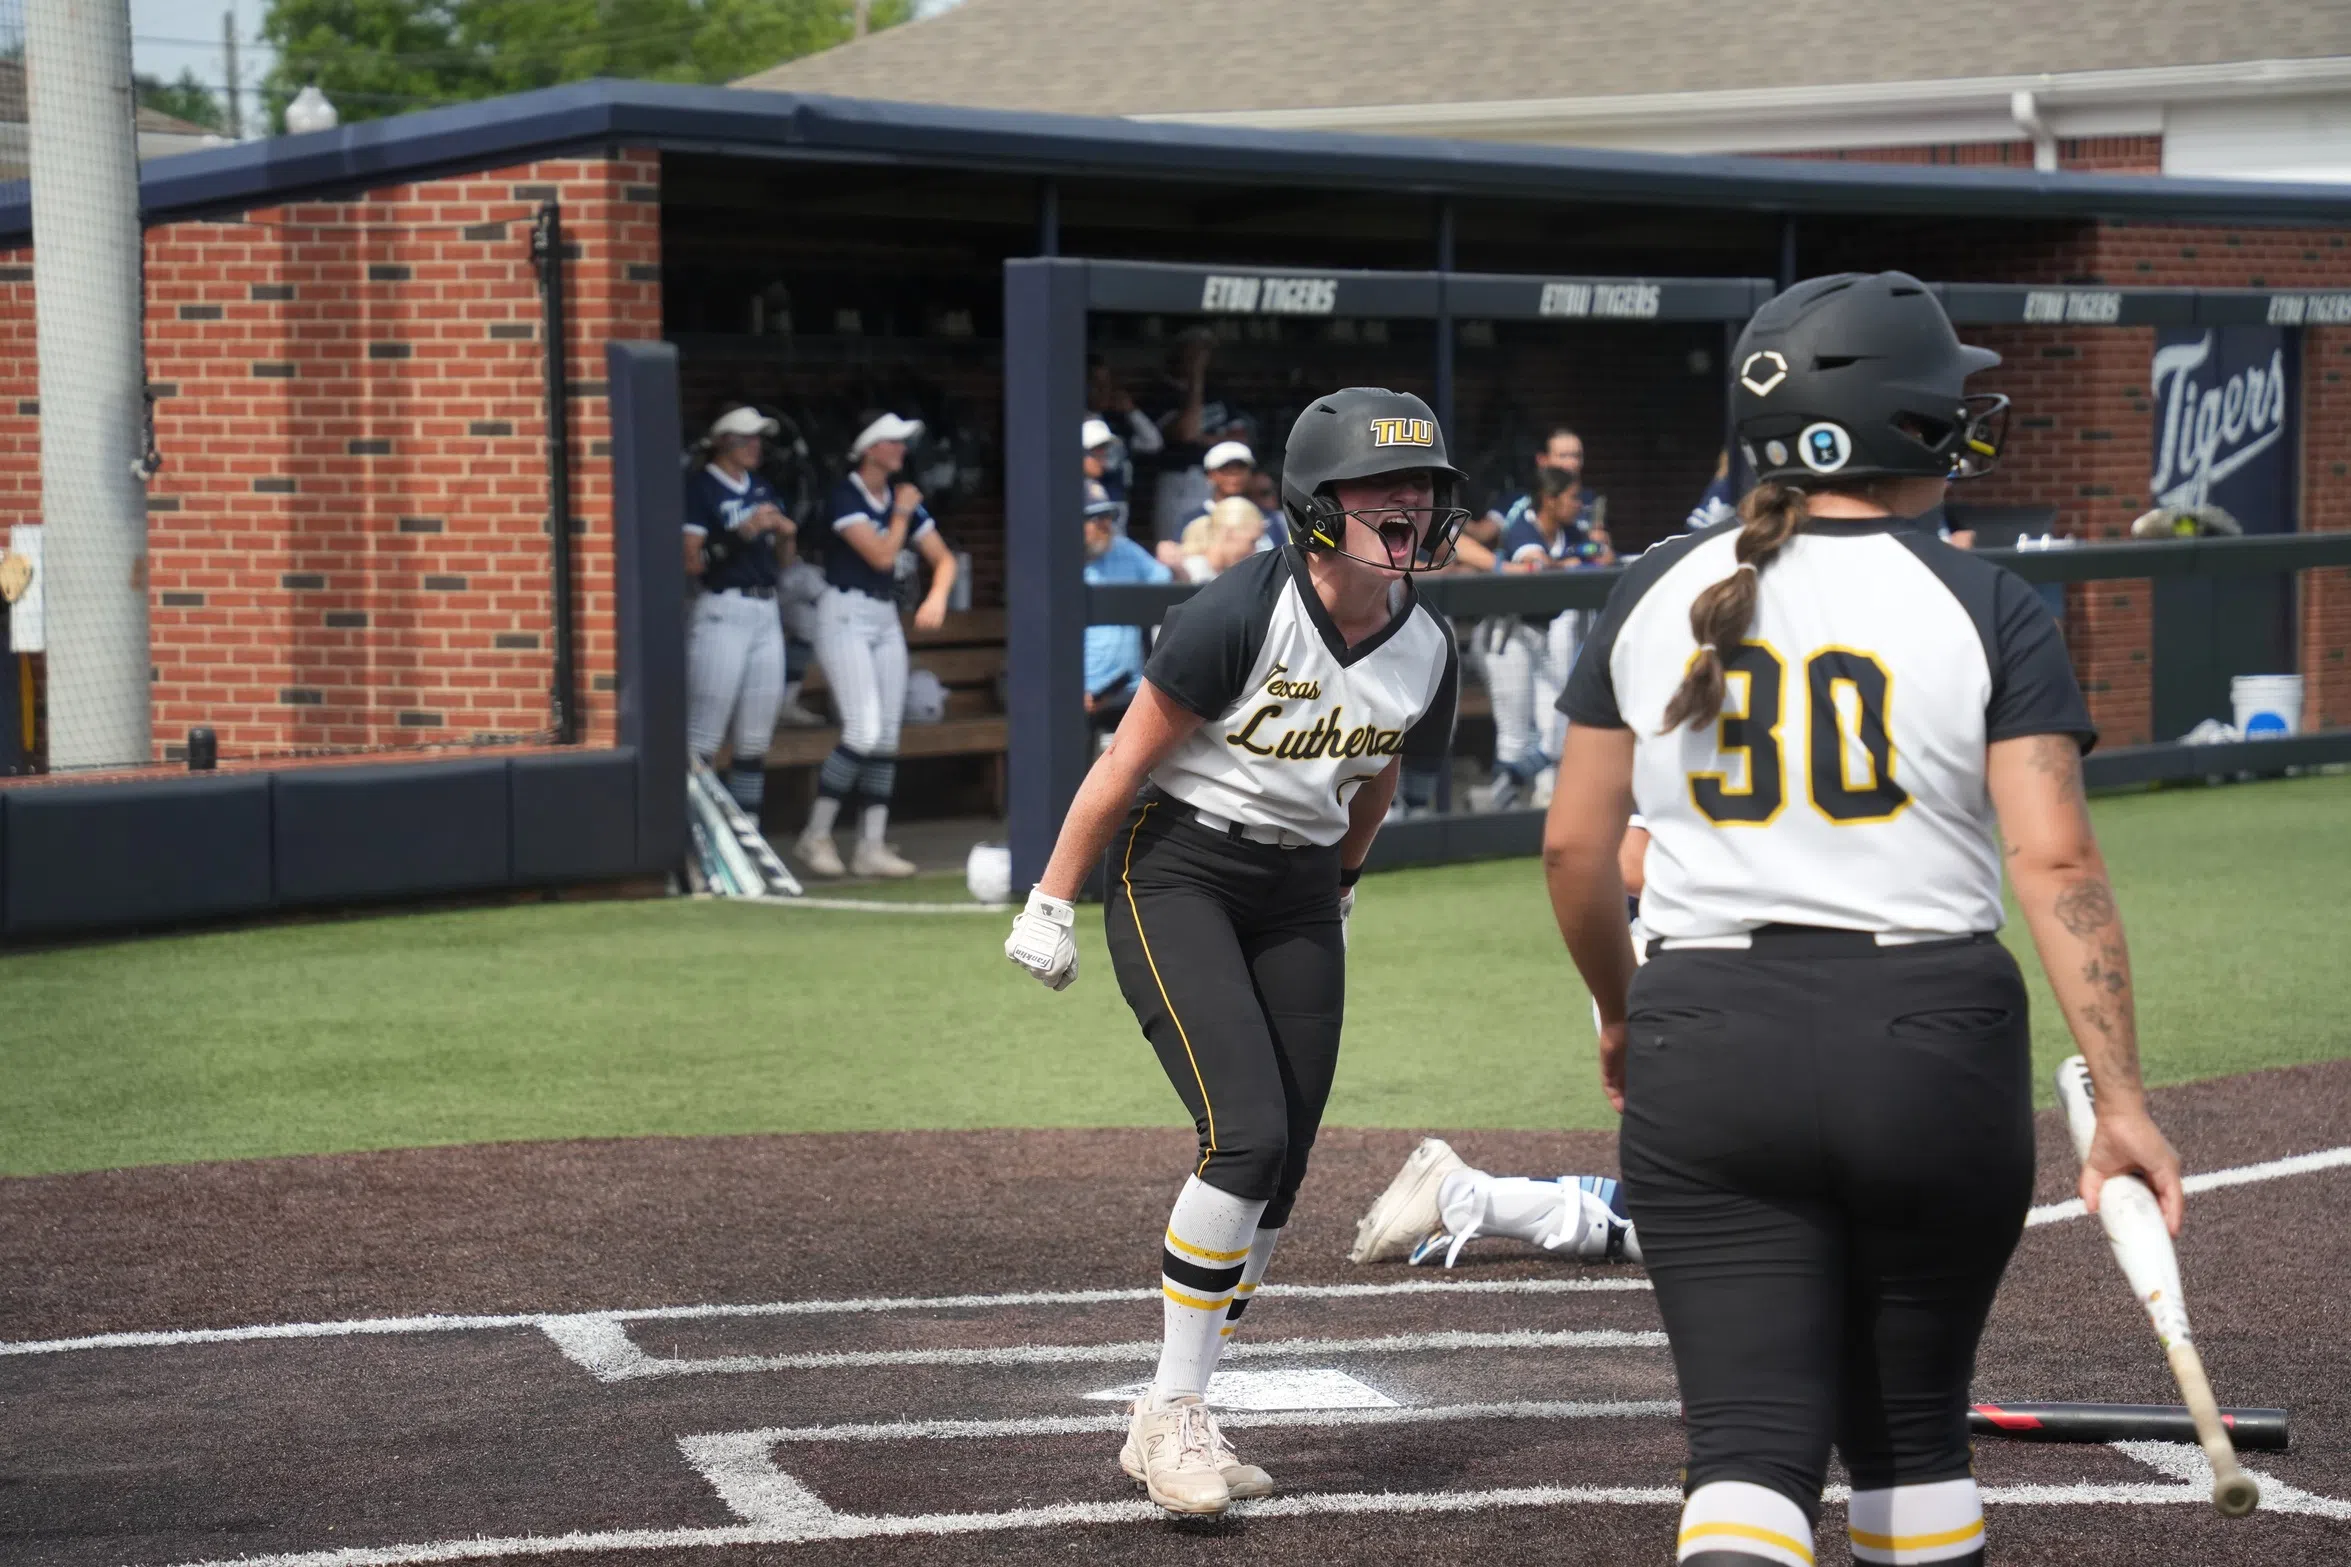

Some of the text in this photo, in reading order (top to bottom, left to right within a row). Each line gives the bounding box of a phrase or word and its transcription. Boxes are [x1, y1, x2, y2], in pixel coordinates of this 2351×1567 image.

[1261, 278, 1338, 315] TIGERS
[1590, 284, 1661, 318] TIGERS
[2065, 292, 2122, 324] TIGERS
[1370, 418, 1433, 447] TLU
[2149, 327, 2286, 507] Tigers
[1264, 662, 1322, 700] Texas
[1226, 704, 1405, 760] Luthera
[1684, 639, 1916, 828] 30
